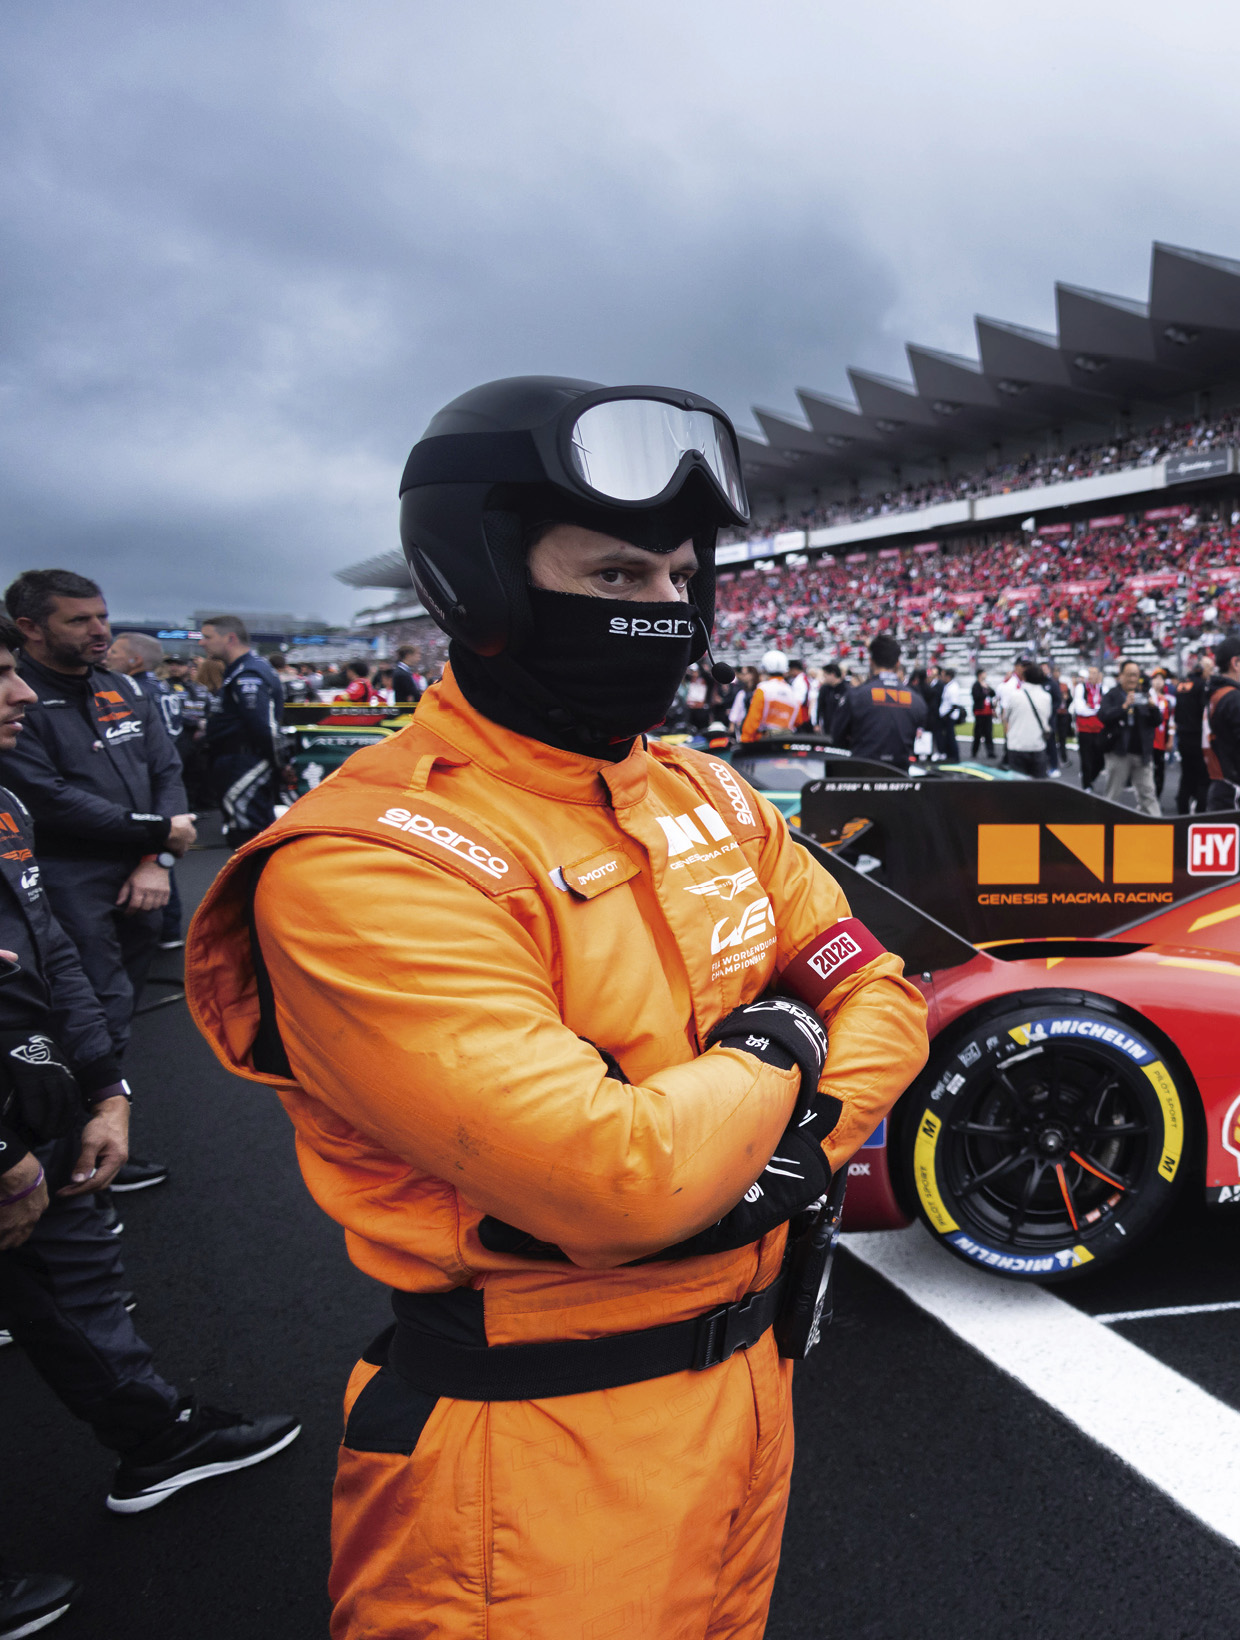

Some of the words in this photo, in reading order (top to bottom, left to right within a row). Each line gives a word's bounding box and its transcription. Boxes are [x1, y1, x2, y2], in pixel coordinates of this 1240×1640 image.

[709, 762, 756, 827] sparco
[378, 807, 510, 880] sparco
[1192, 833, 1235, 866] HY
[978, 893, 1048, 905] GENESIS
[1052, 892, 1111, 904] MAGMA
[1114, 892, 1173, 903] RACING
[812, 936, 858, 975] 2026
[1049, 1020, 1147, 1060] MICHELIN
[1154, 1070, 1171, 1095] PILOT
[1166, 1097, 1178, 1129] SPORT
[922, 1118, 937, 1139] M
[1162, 1155, 1176, 1174] M
[955, 1236, 1054, 1272] MICHELIN
